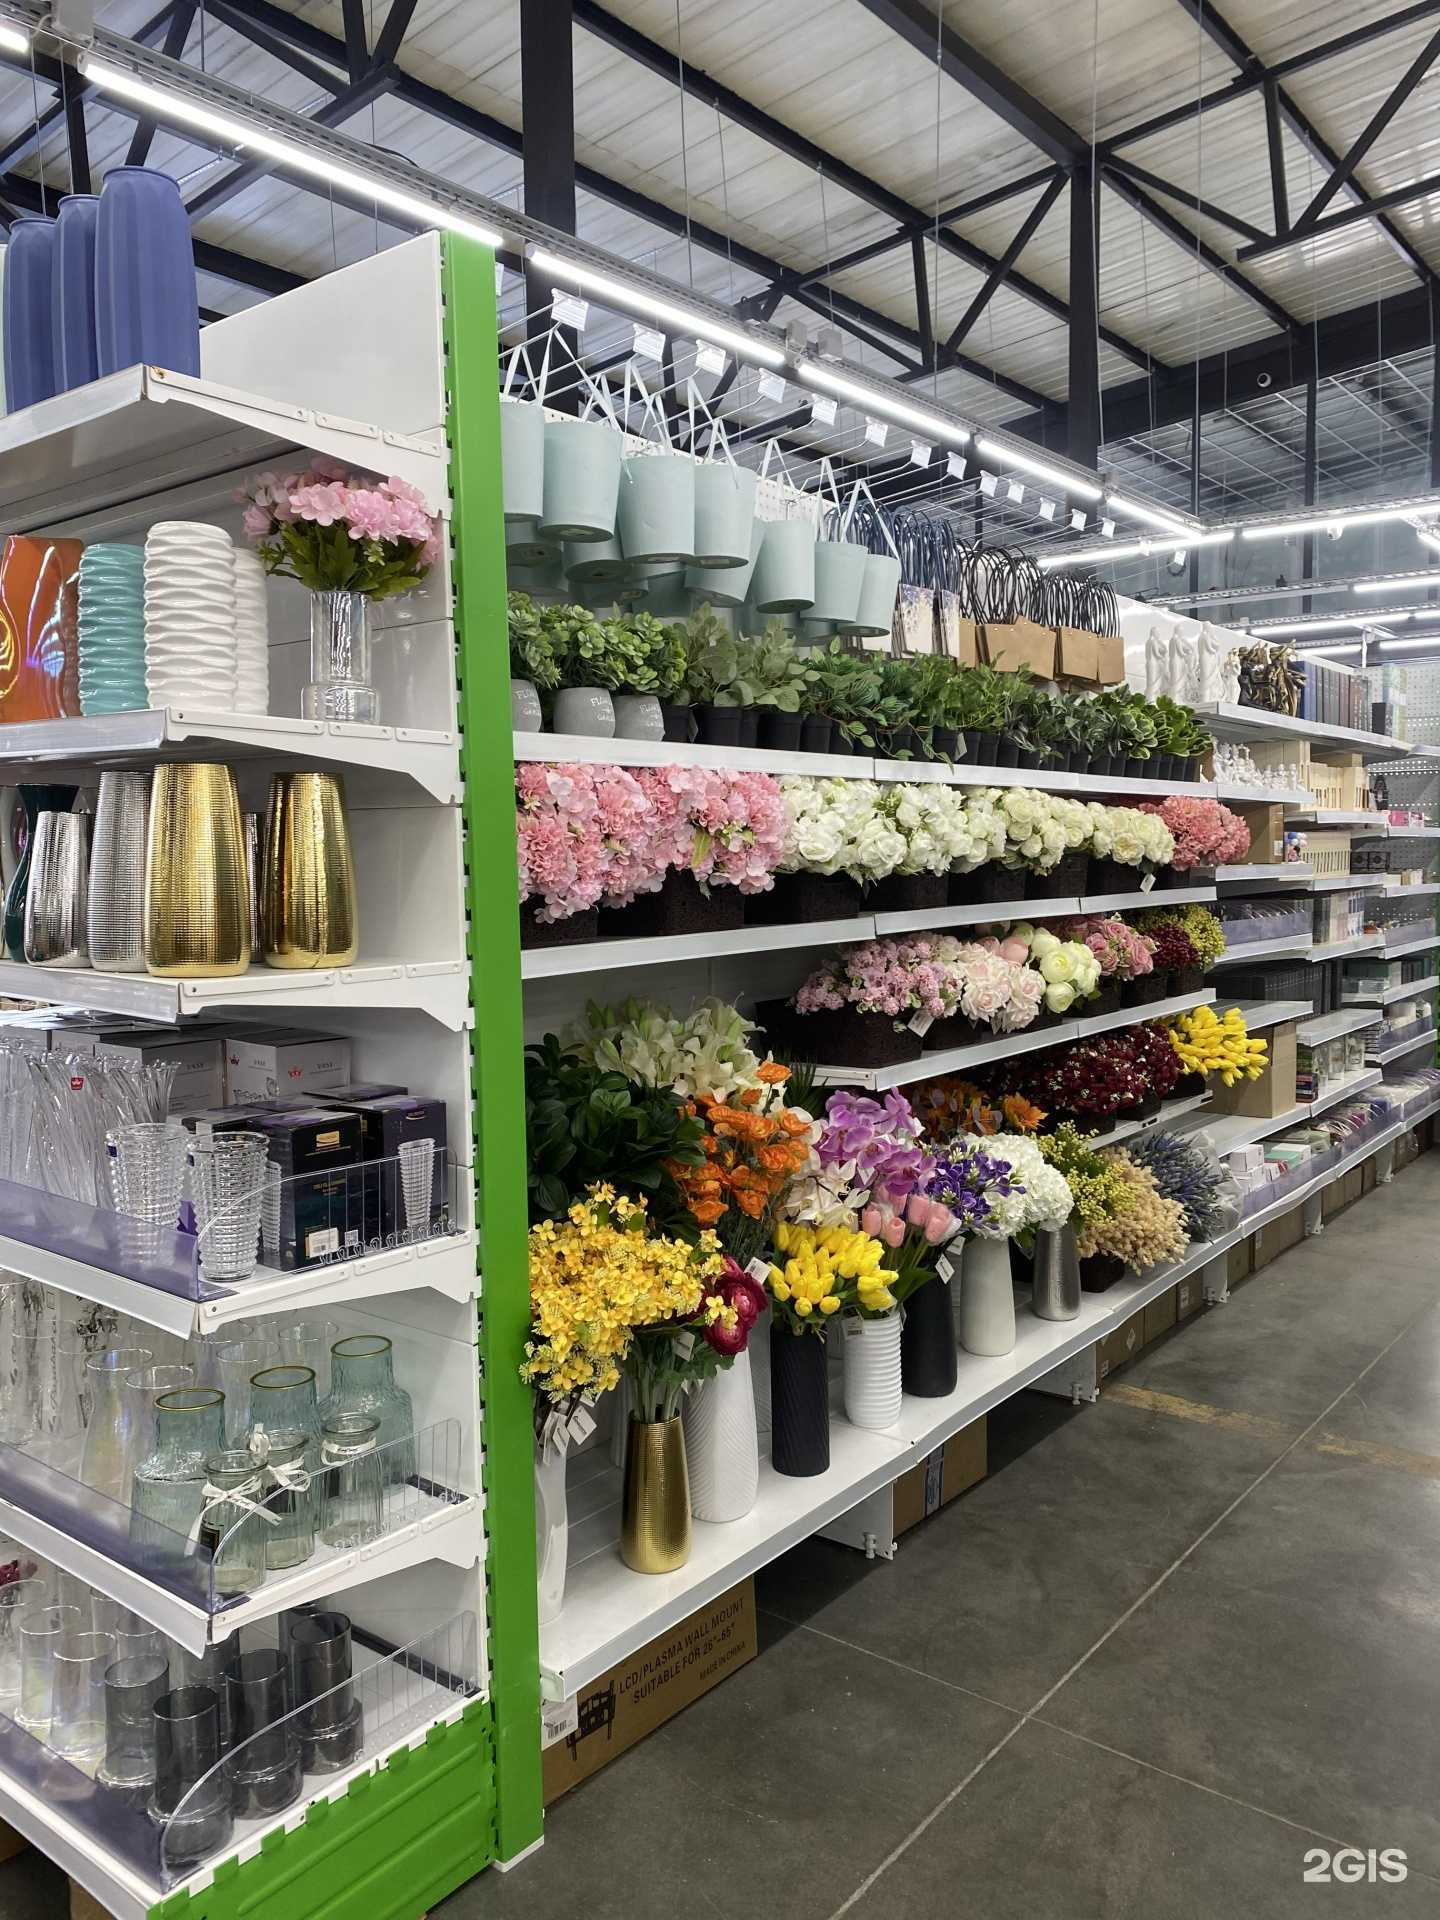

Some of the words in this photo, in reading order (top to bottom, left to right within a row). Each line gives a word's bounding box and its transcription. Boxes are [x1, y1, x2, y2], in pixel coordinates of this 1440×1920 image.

[620, 1641, 684, 1694] LCD/PLASMA
[684, 1623, 710, 1647] WALL
[711, 1597, 744, 1627] MOUNT
[633, 1661, 680, 1704] SUITABLE
[682, 1647, 701, 1670] FOR
